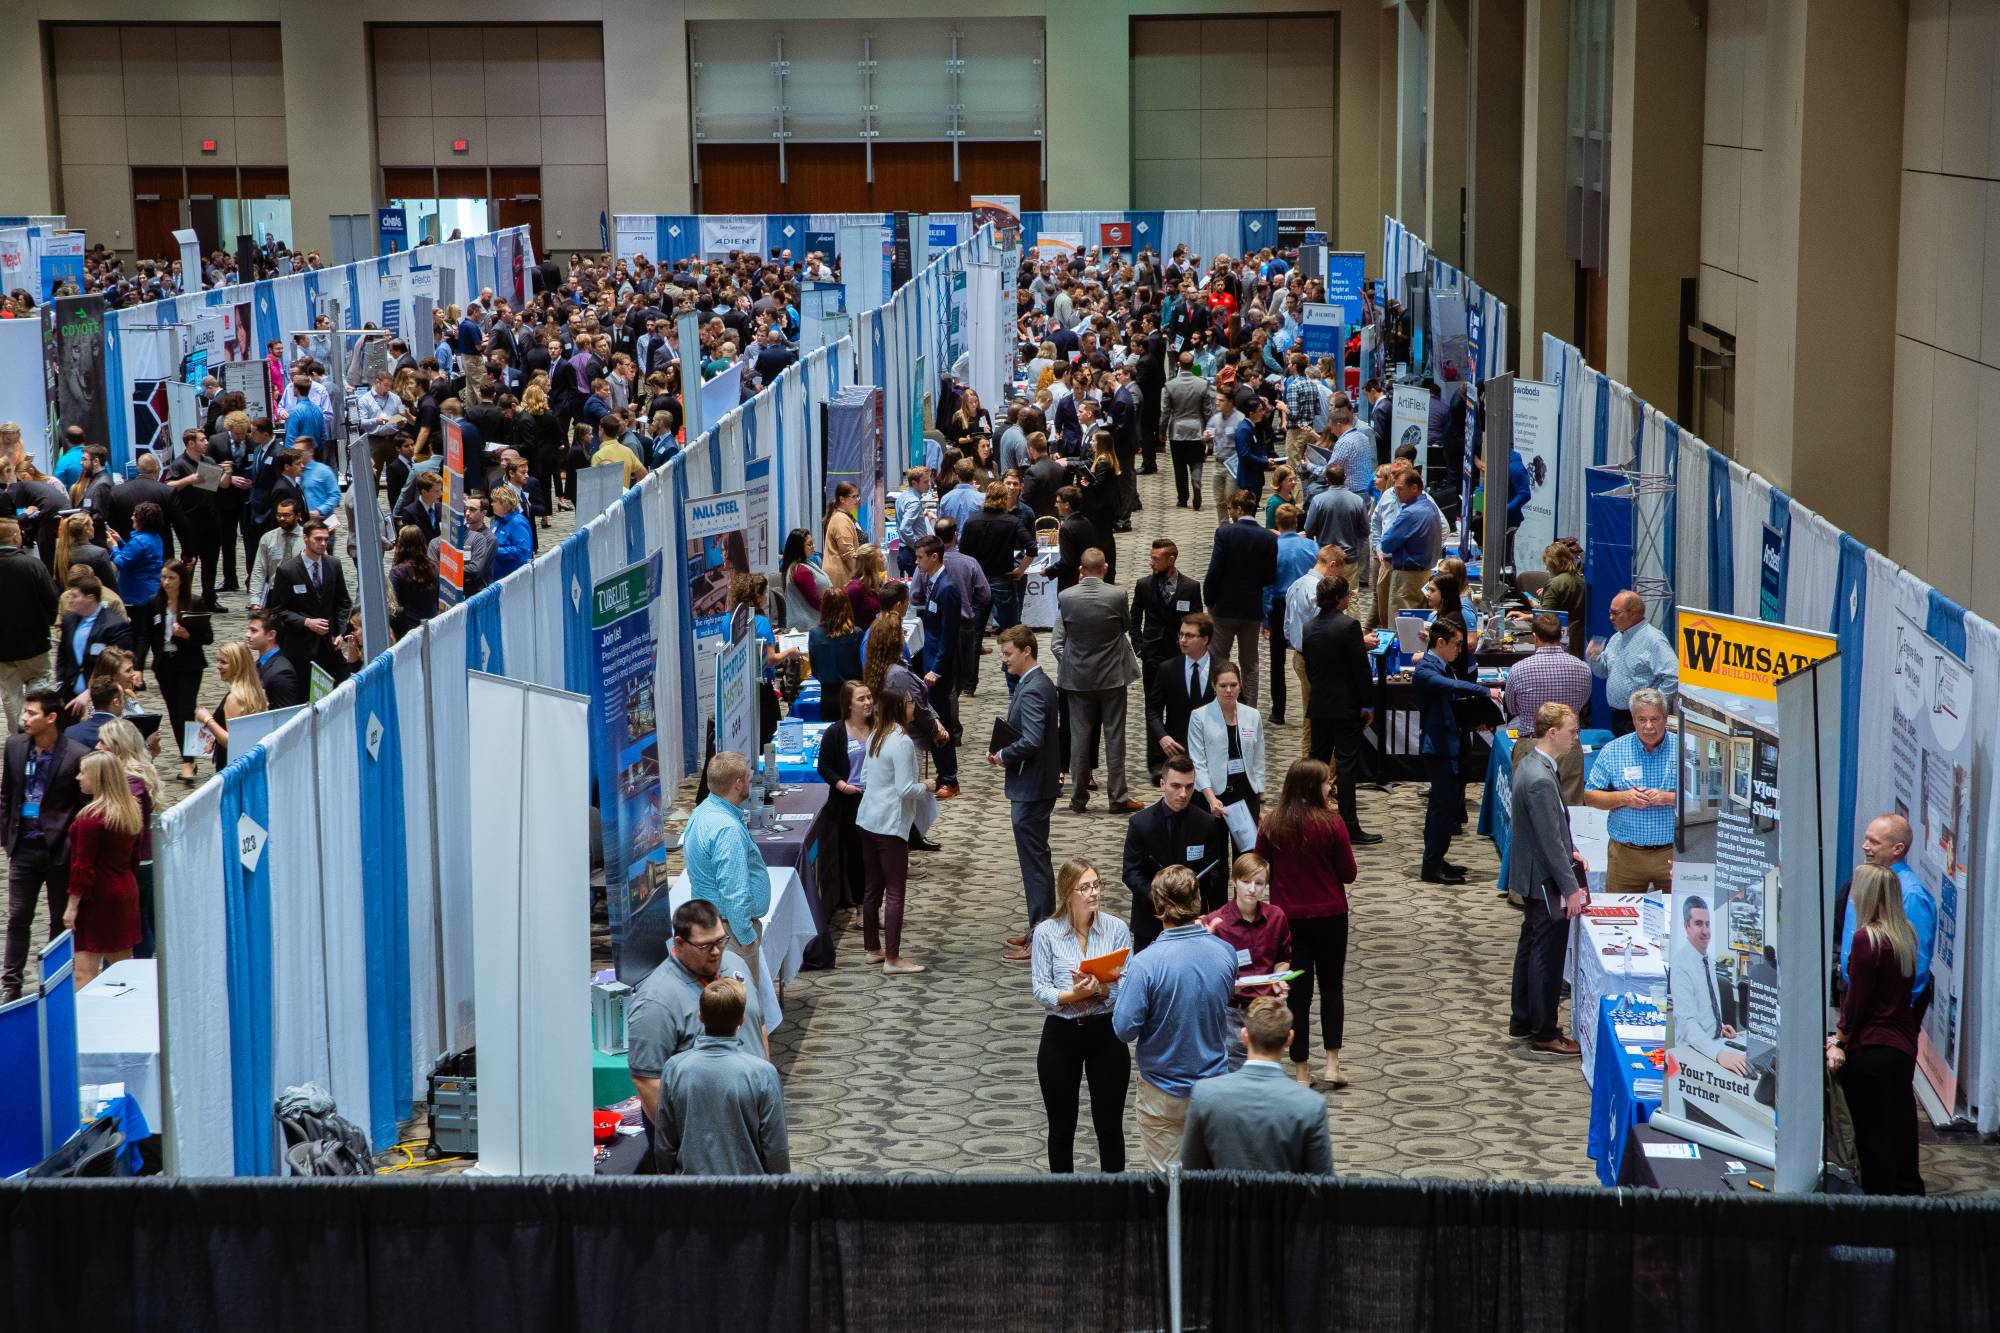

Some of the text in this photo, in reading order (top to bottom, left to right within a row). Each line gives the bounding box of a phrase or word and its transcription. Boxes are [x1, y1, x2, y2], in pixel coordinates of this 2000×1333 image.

[711, 238, 757, 248] ADIENT
[61, 321, 100, 338] COYOTE
[1397, 396, 1427, 412] ArtiFlex
[692, 503, 715, 521] MILL
[715, 499, 739, 516] STEEL
[1683, 627, 1818, 676] WIMSAT
[1721, 666, 1769, 684] BUILDING
[1718, 809, 1751, 824] Professional
[242, 834, 257, 855] J23
[1740, 833, 1765, 847] branches
[1716, 851, 1751, 865] environment
[1746, 846, 1766, 858] perfect
[1749, 979, 1764, 990] Lean
[1748, 1011, 1760, 1021] you
[1678, 1062, 1750, 1097] Your Trusted
[1678, 1079, 1720, 1104] Partner
